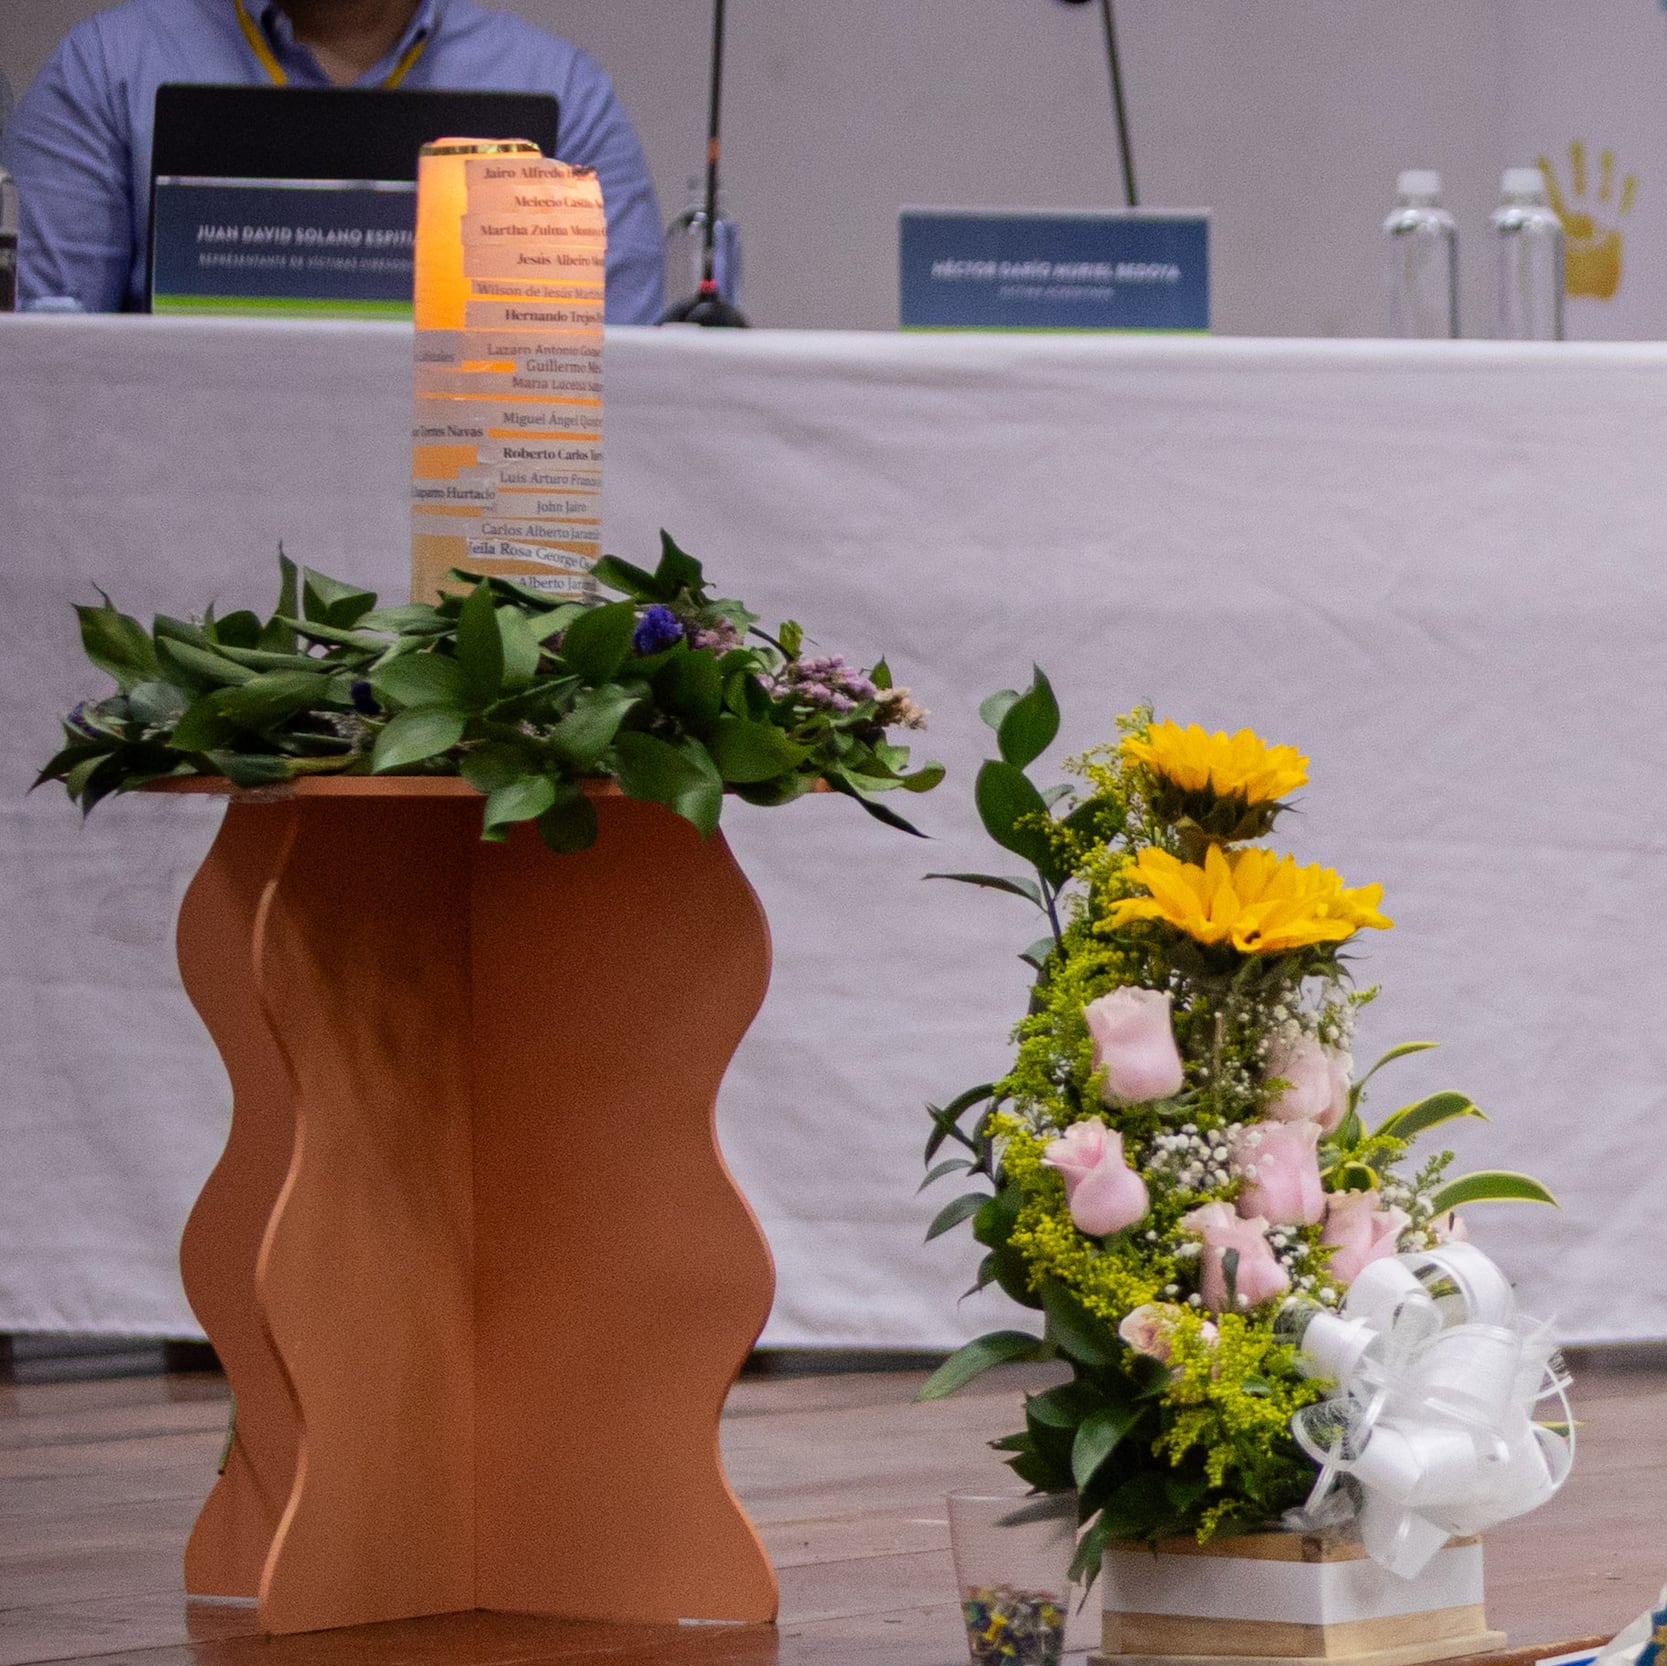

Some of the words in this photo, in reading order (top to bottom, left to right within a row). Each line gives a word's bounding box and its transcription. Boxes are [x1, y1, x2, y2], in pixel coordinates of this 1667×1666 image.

[484, 167, 515, 179] Jairo
[521, 167, 563, 178] Alfredo
[197, 224, 239, 243] JUAN
[242, 226, 292, 245] DAVID
[296, 227, 362, 247] SOLANO
[365, 229, 415, 248] ESPITI
[480, 224, 528, 236] Martha
[531, 224, 568, 236] Zulma
[517, 252, 551, 265] Jesús
[477, 284, 522, 296] Wilson
[525, 285, 541, 296] de
[505, 309, 568, 322] Hernando
[526, 359, 586, 373] Guillermo
[503, 413, 546, 428] Miguel
[548, 410, 578, 427] Ángel
[448, 426, 484, 438] Navas
[503, 448, 556, 460] Roberto
[558, 448, 588, 460] Carlos
[500, 471, 526, 484] Luis
[530, 472, 568, 484] Arturo
[537, 501, 563, 514] John
[481, 523, 522, 536] Carlos
[524, 525, 570, 538] Alberto
[501, 543, 532, 558] Rosa
